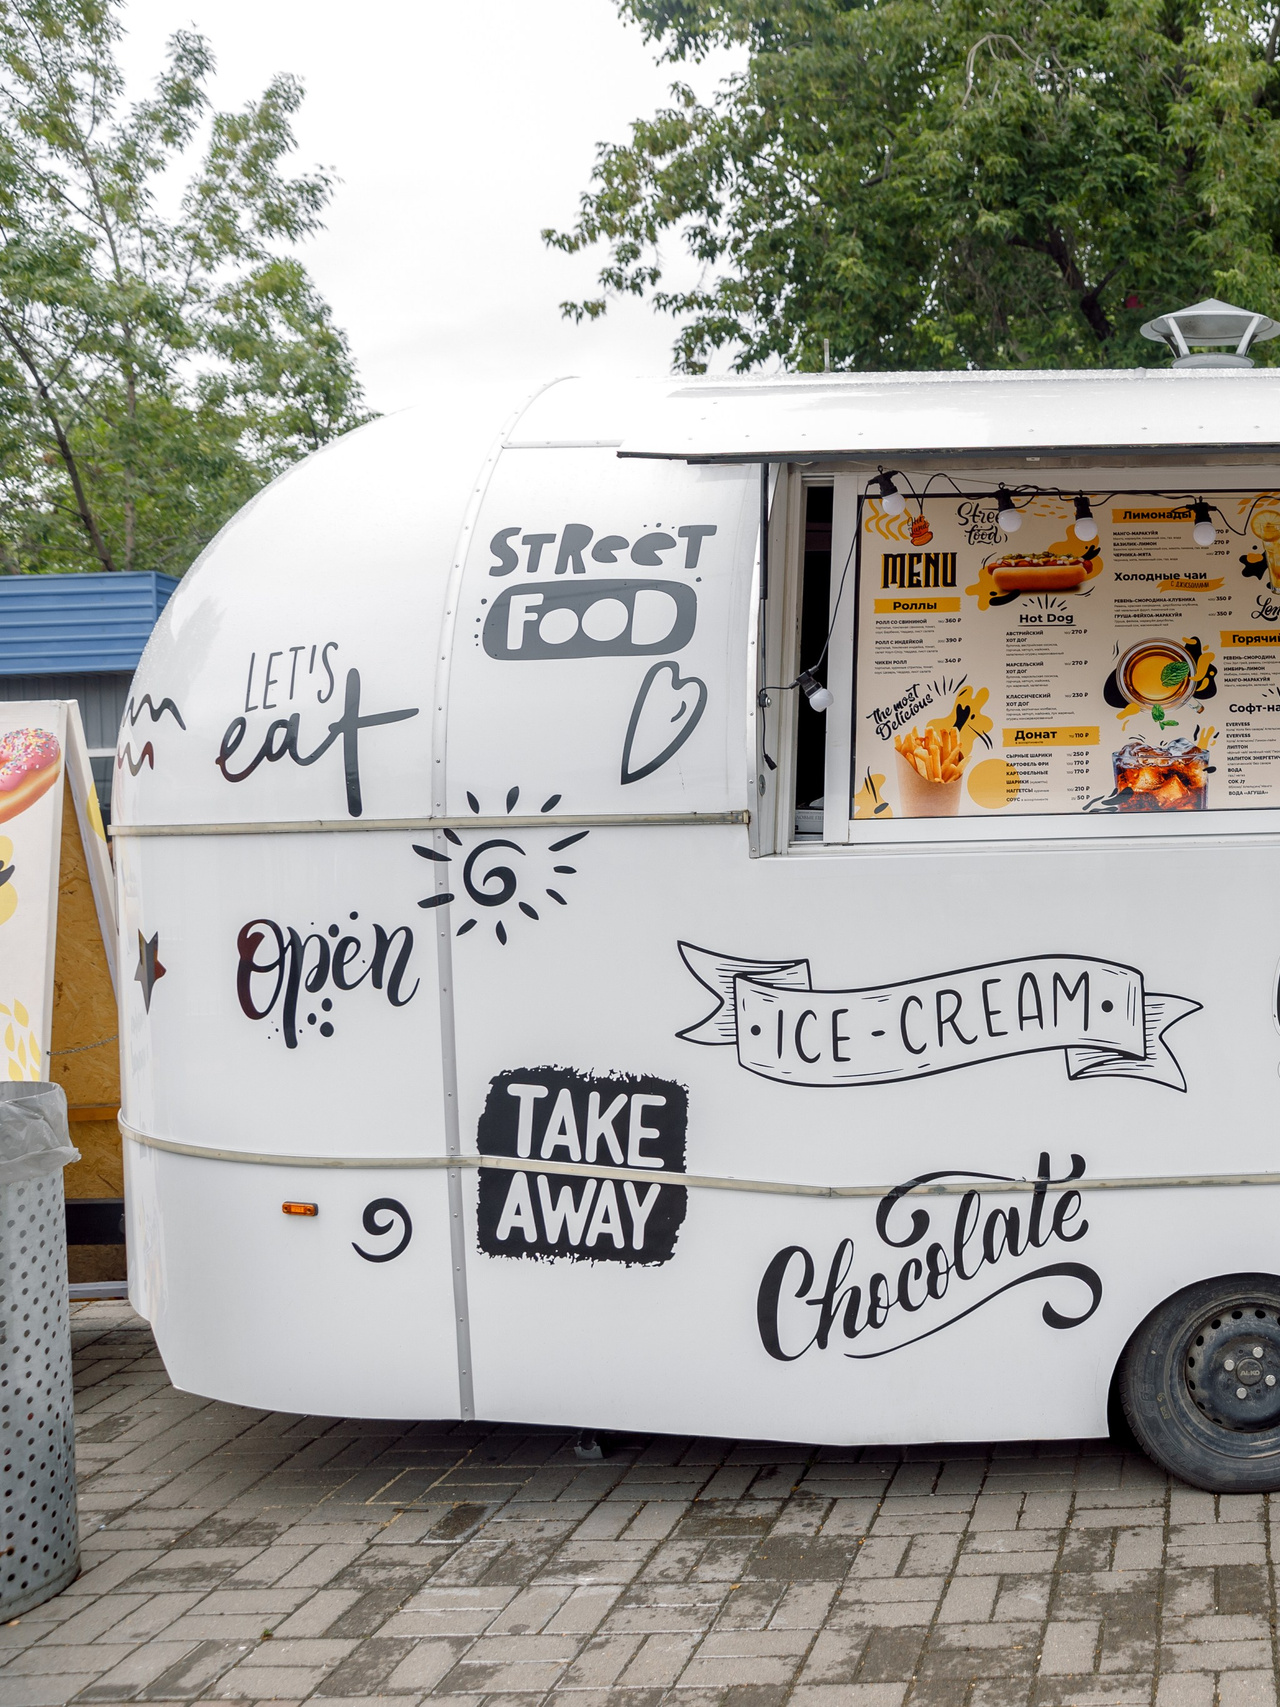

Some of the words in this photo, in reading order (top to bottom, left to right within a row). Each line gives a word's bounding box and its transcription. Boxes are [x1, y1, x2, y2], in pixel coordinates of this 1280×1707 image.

[1123, 511, 1192, 520] Лимонады
[964, 524, 1002, 546] food
[880, 552, 957, 589] MENU
[1114, 572, 1180, 581] Холодные
[1184, 572, 1207, 580] чаи
[507, 590, 678, 650] FOOD
[893, 601, 937, 611] Роллы
[1020, 614, 1043, 623] Hot
[1047, 614, 1074, 624] Dog
[244, 641, 338, 712] LET'S
[866, 708, 892, 724] The
[876, 694, 933, 740] Delicious
[215, 668, 420, 818] eat
[1015, 730, 1057, 741] Донат
[507, 1083, 667, 1168] TAKE
[496, 1171, 661, 1250] AWAY
[756, 1151, 1090, 1362] Chocolate
